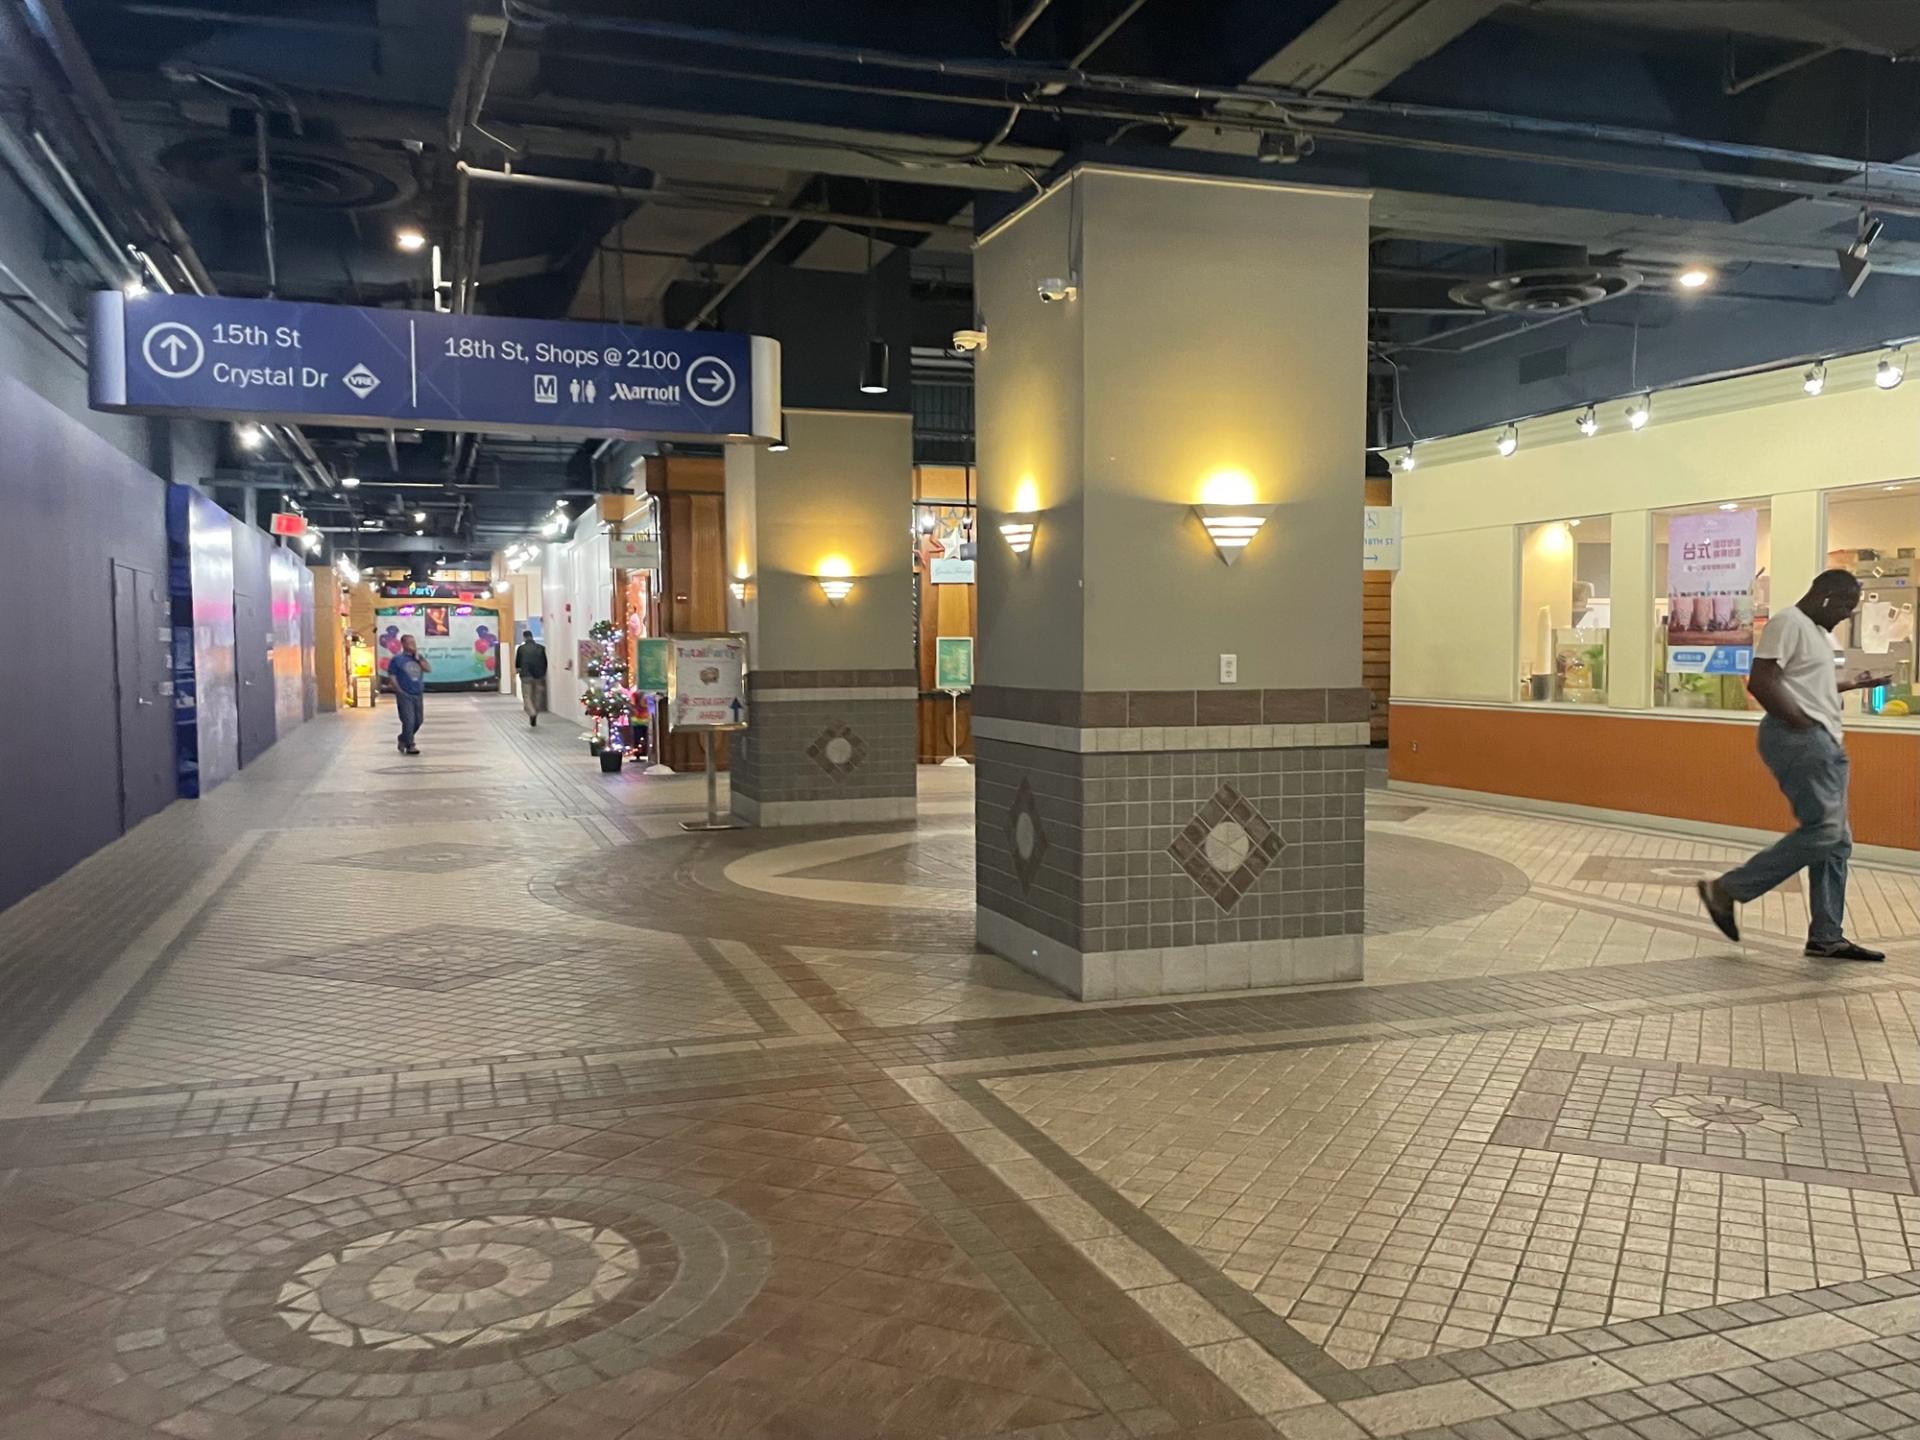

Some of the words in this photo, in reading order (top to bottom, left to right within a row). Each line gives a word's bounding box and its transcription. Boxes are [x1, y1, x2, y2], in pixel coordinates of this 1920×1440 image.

[212, 323, 268, 346] 15th
[275, 327, 303, 348] St
[444, 336, 496, 359] 18th
[501, 340, 530, 365] St,
[535, 342, 599, 368] Shops
[603, 347, 622, 367] @
[626, 348, 680, 370] 2100
[213, 362, 294, 388] Crystal
[302, 367, 328, 387] Dr
[535, 375, 556, 396] M
[609, 381, 680, 401] Marriott
